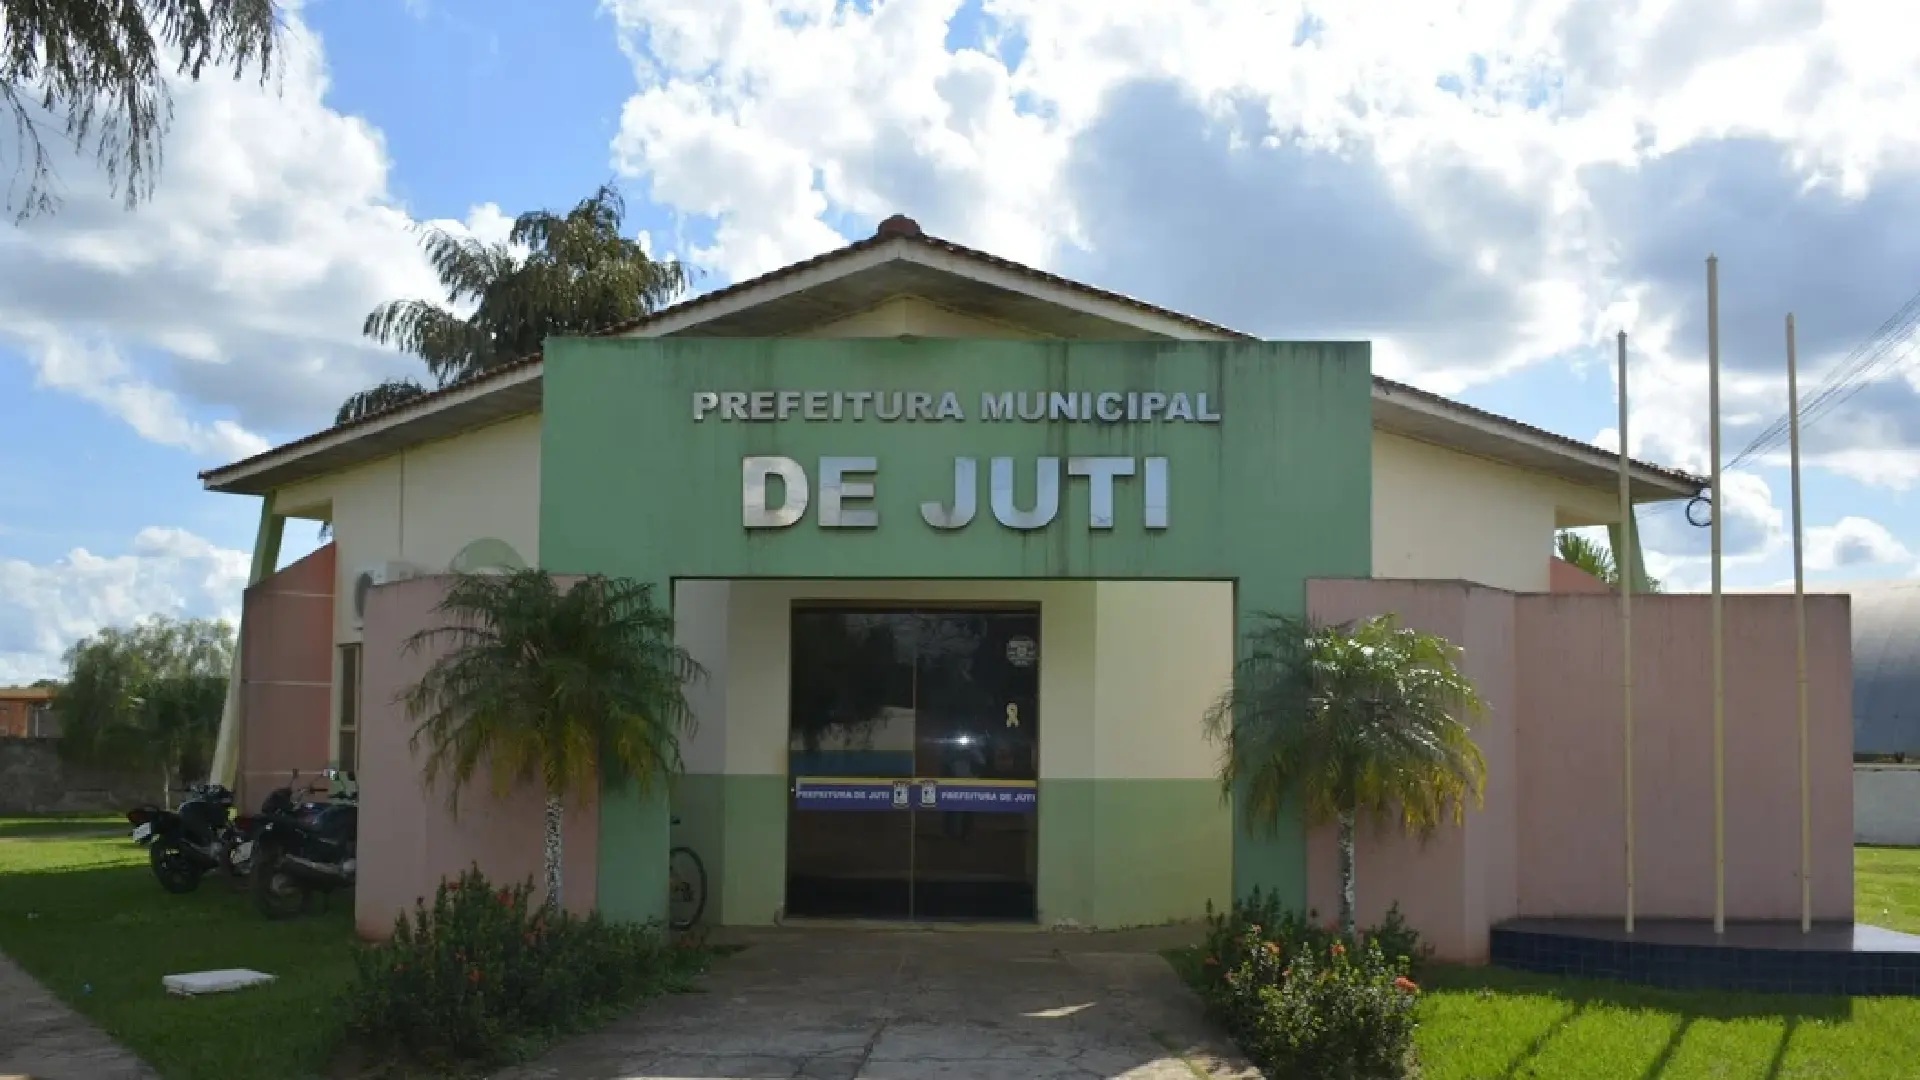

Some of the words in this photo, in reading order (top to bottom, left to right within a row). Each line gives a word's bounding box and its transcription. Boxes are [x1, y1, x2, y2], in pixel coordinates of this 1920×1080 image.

[692, 391, 965, 422] PREFEITURA
[981, 391, 1222, 423] MUNICIPAL
[742, 456, 879, 528] DE
[920, 456, 1170, 529] JUTI
[798, 790, 853, 799] PREFEITURA
[855, 790, 866, 799] DE
[869, 790, 890, 799] JUTI
[941, 791, 997, 801] PREFEITURA
[1000, 793, 1012, 802] DE
[1015, 793, 1036, 803] JUTI
